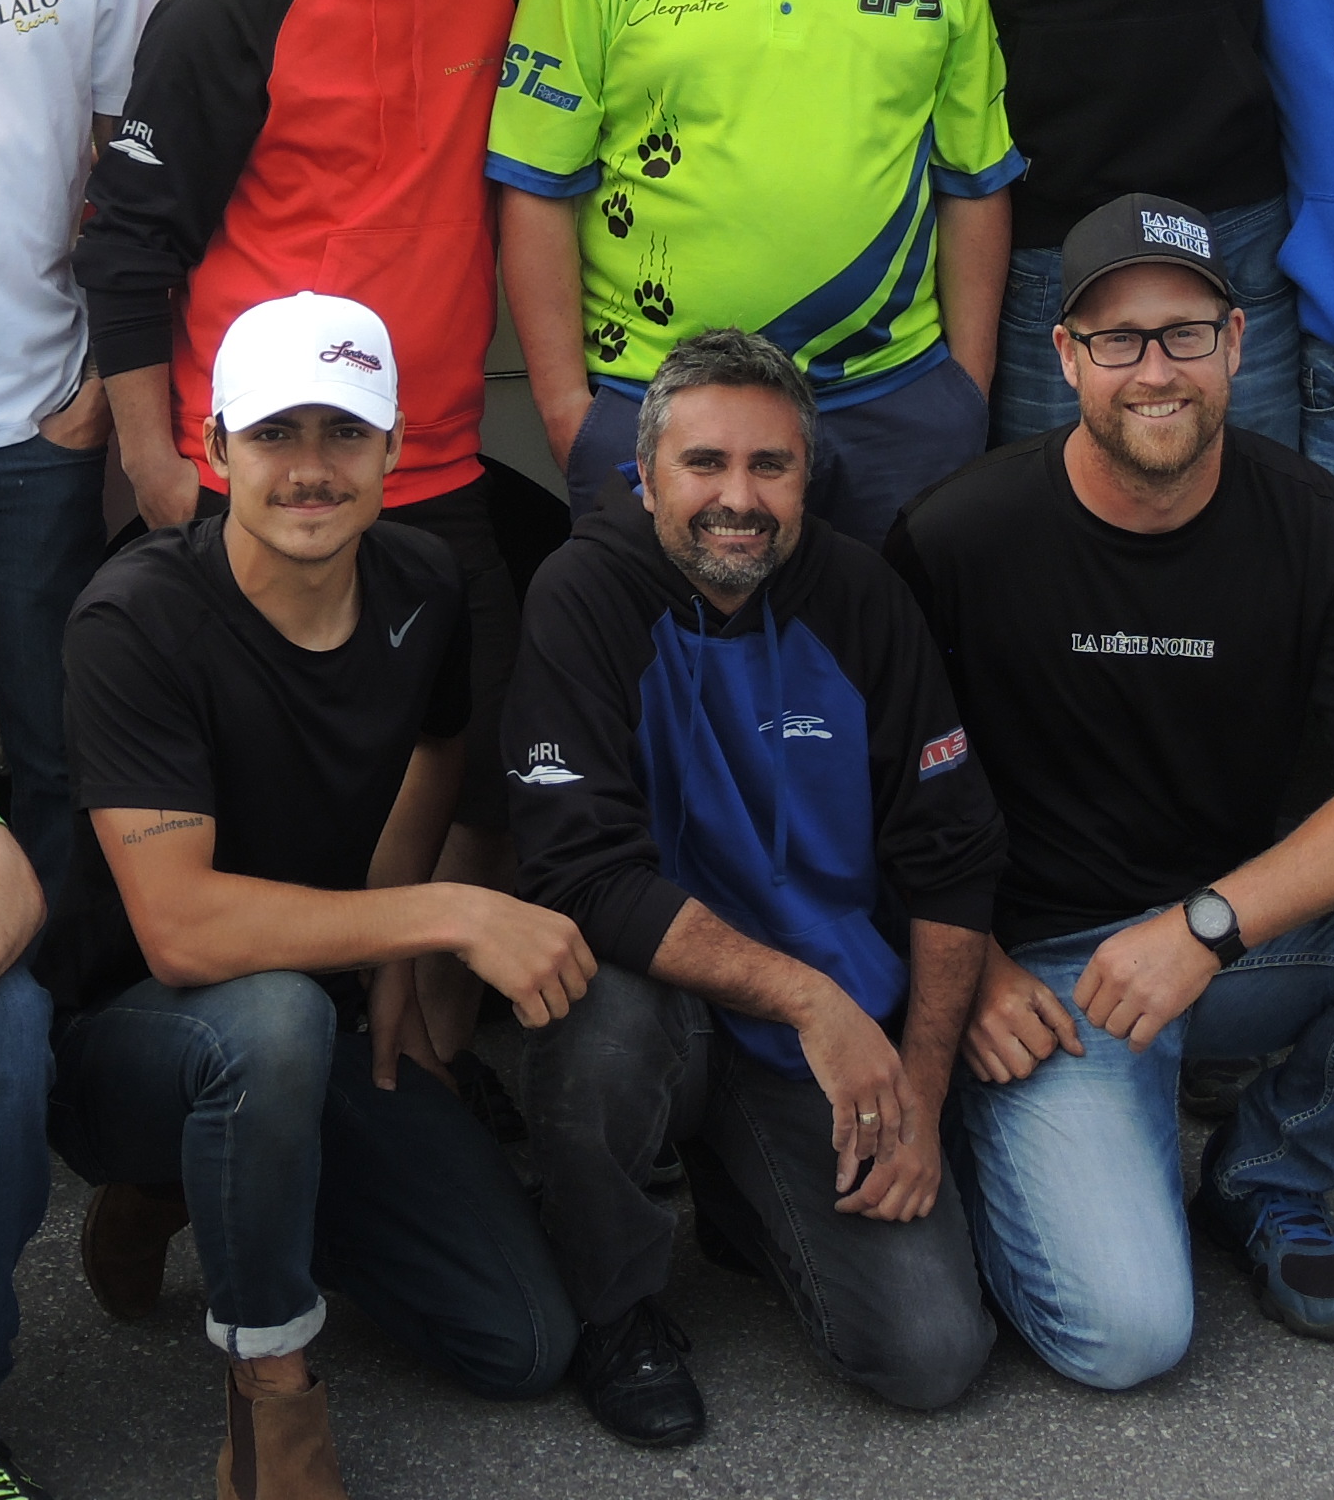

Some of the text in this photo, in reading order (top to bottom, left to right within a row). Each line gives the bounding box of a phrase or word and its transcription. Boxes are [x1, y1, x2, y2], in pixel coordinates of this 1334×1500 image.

[15, 10, 59, 35] Racing
[536, 84, 574, 109] Racing
[122, 119, 154, 149] HRL
[1141, 211, 1208, 242] LA BÊTE
[1143, 225, 1210, 258] NOIRE
[1072, 631, 1214, 658] LA BÊTE NOIRE
[528, 742, 565, 766] HRL
